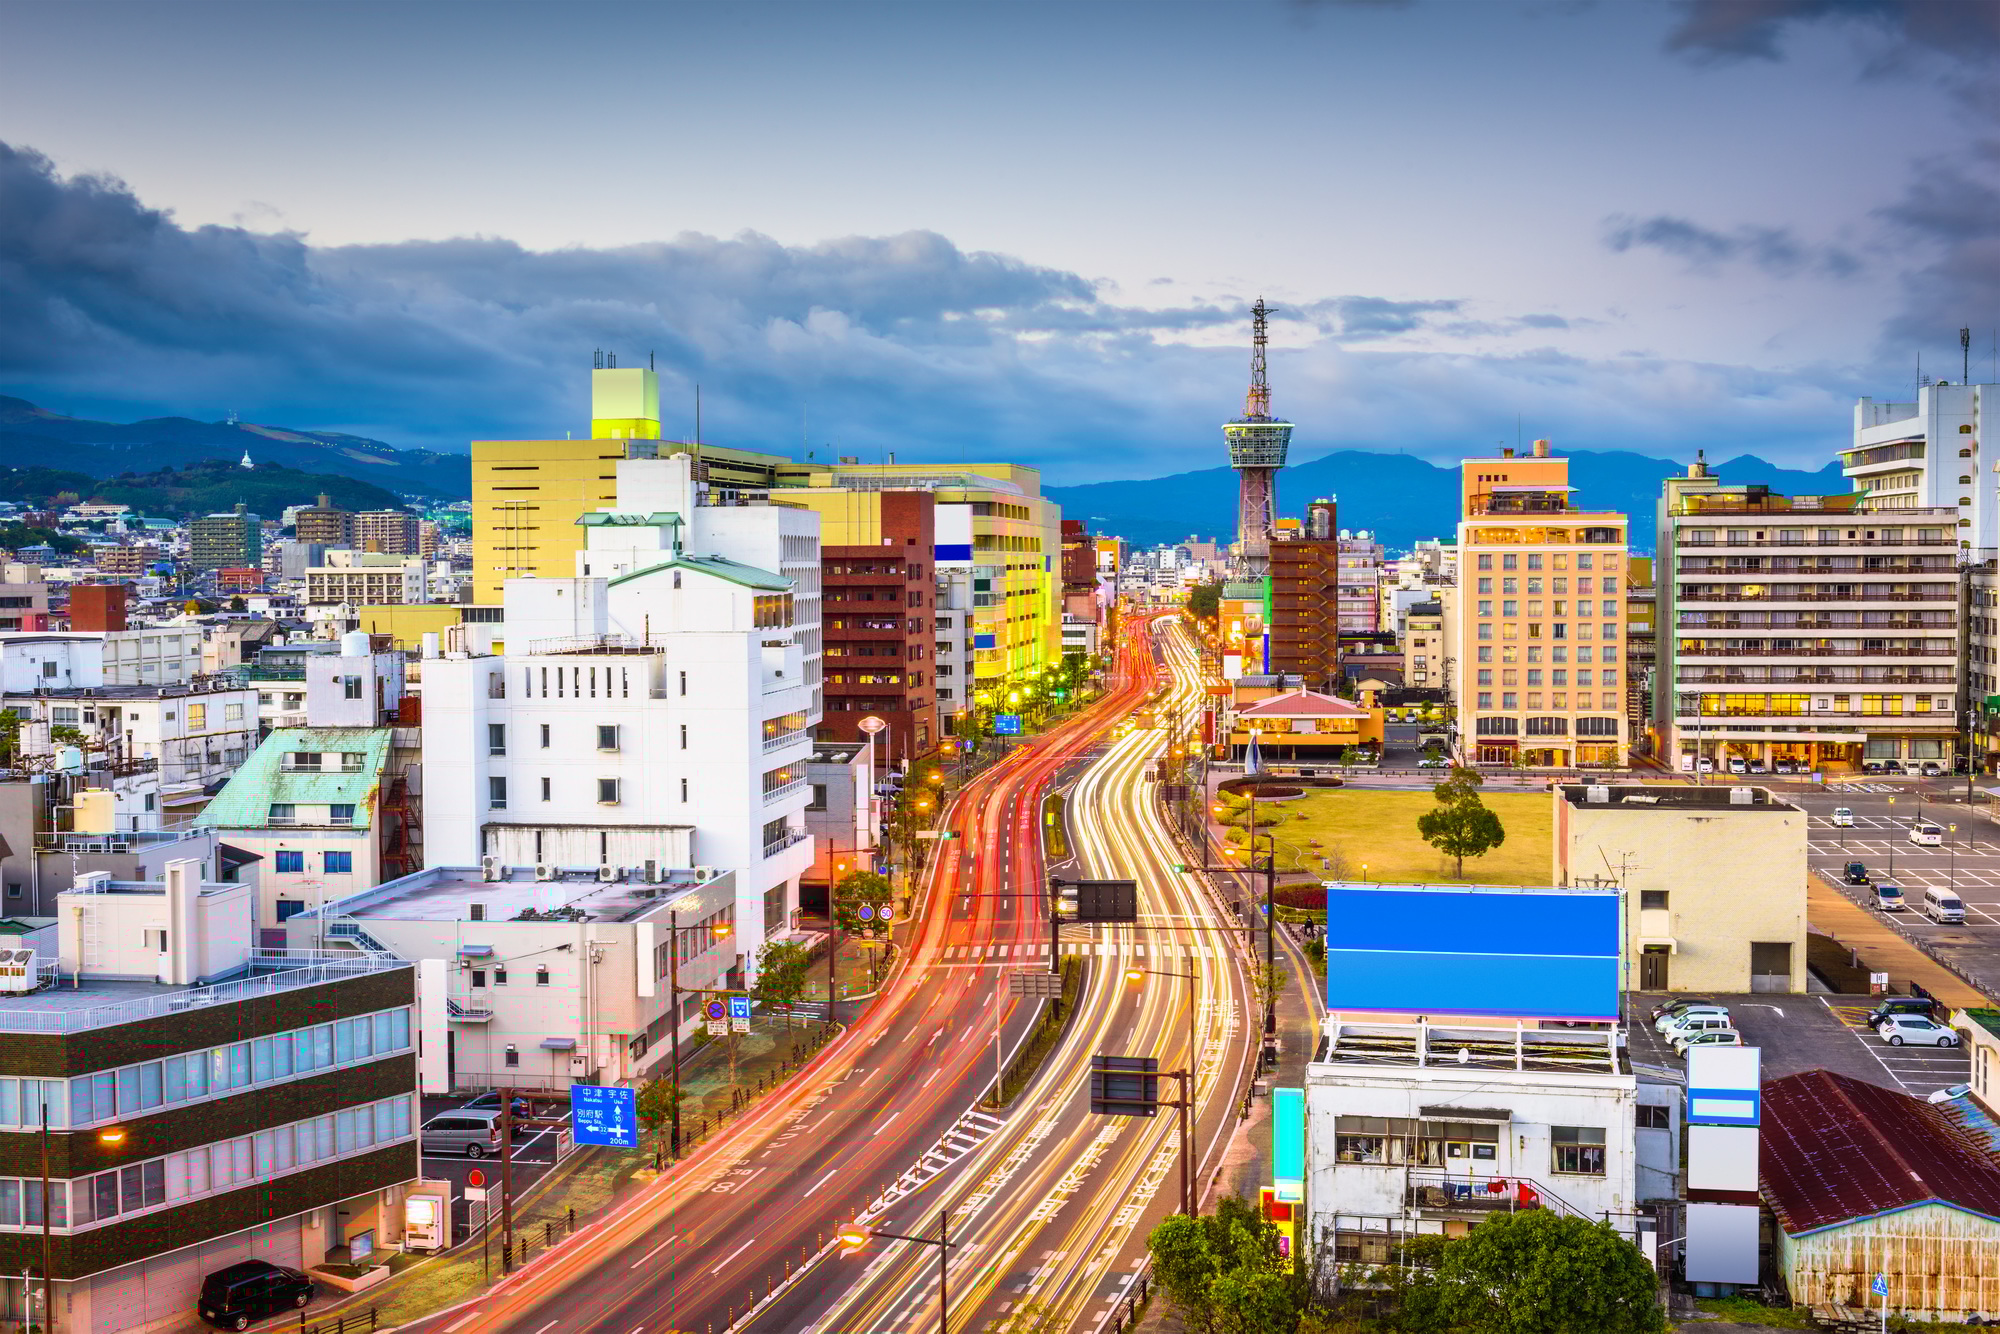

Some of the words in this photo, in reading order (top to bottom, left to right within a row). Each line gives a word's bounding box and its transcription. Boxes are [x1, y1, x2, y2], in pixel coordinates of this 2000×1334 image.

[881, 909, 891, 917] 50
[583, 1088, 603, 1097] 中津
[608, 1089, 629, 1100] 宇佐
[577, 1109, 604, 1119] 別府駅
[610, 1137, 629, 1145] 200m
